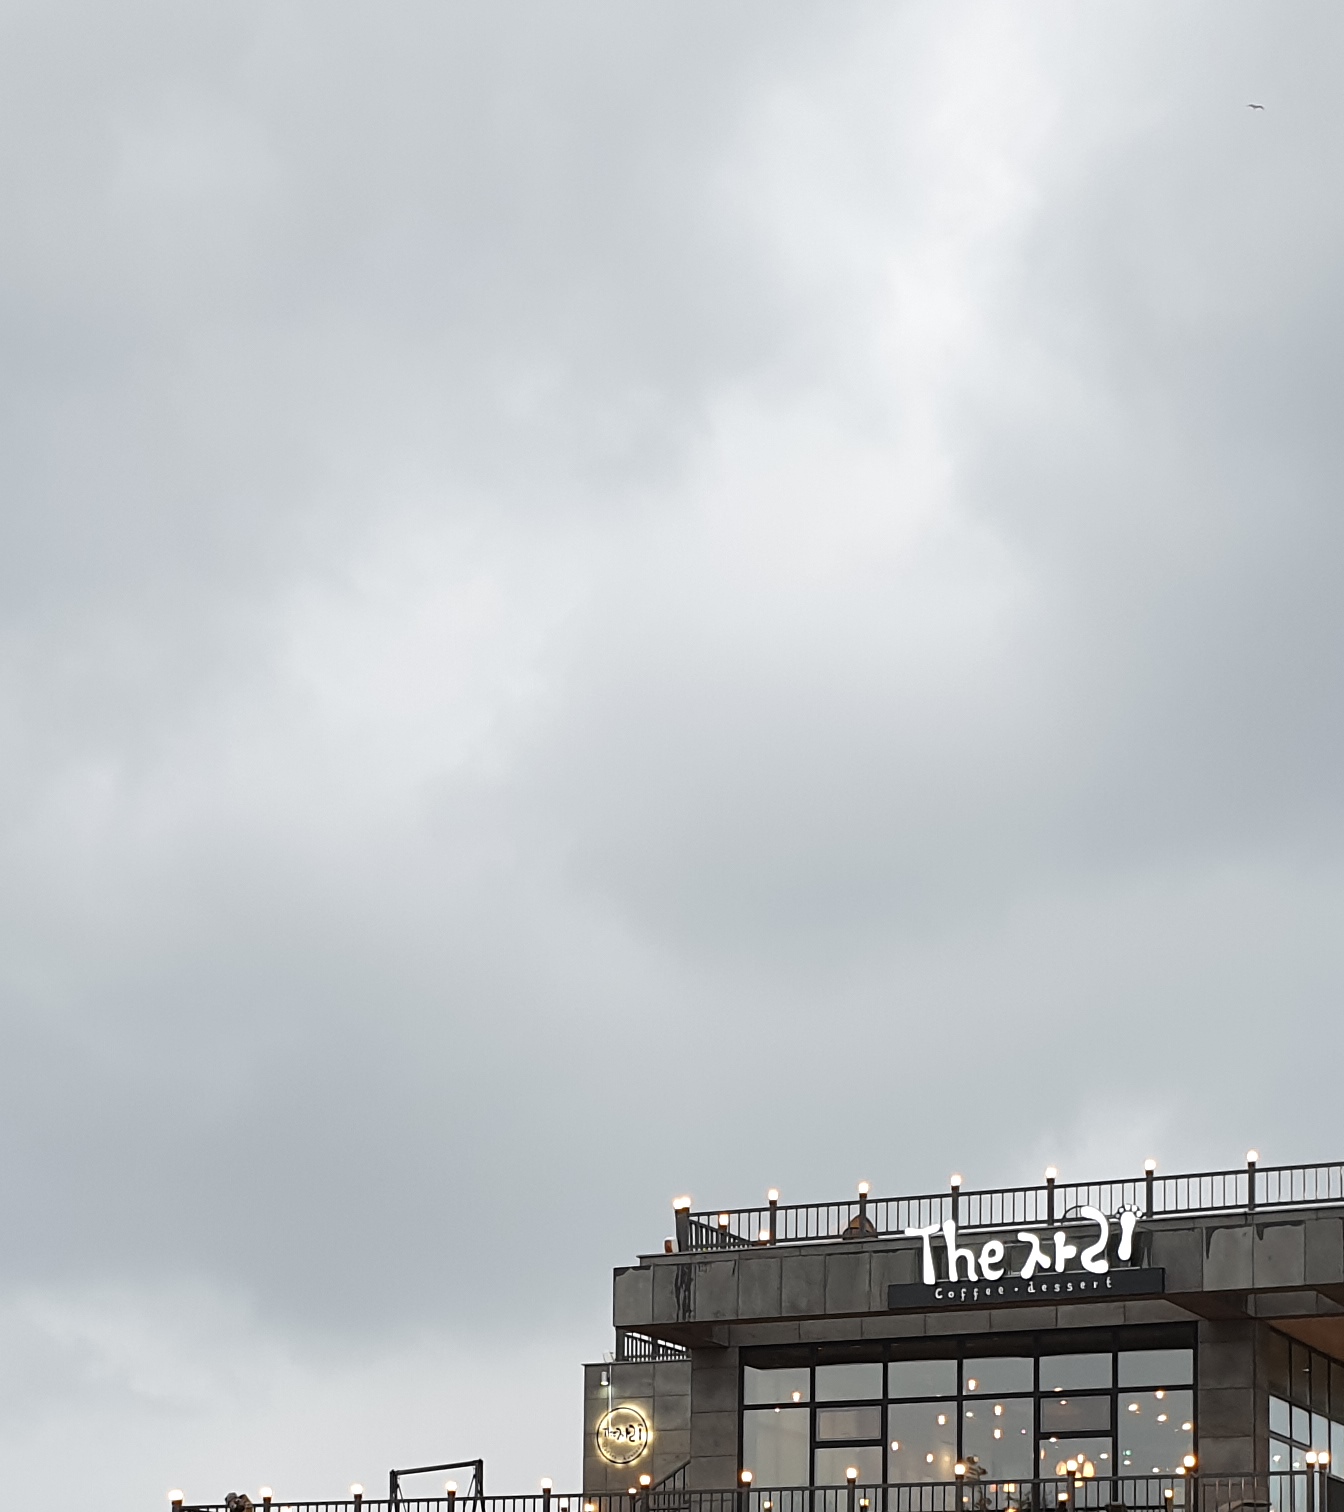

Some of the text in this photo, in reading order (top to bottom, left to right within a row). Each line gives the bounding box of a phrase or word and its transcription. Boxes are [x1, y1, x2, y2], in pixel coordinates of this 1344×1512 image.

[905, 1204, 1143, 1285] The 자리
[934, 1276, 1112, 1302] Coffee dessert
